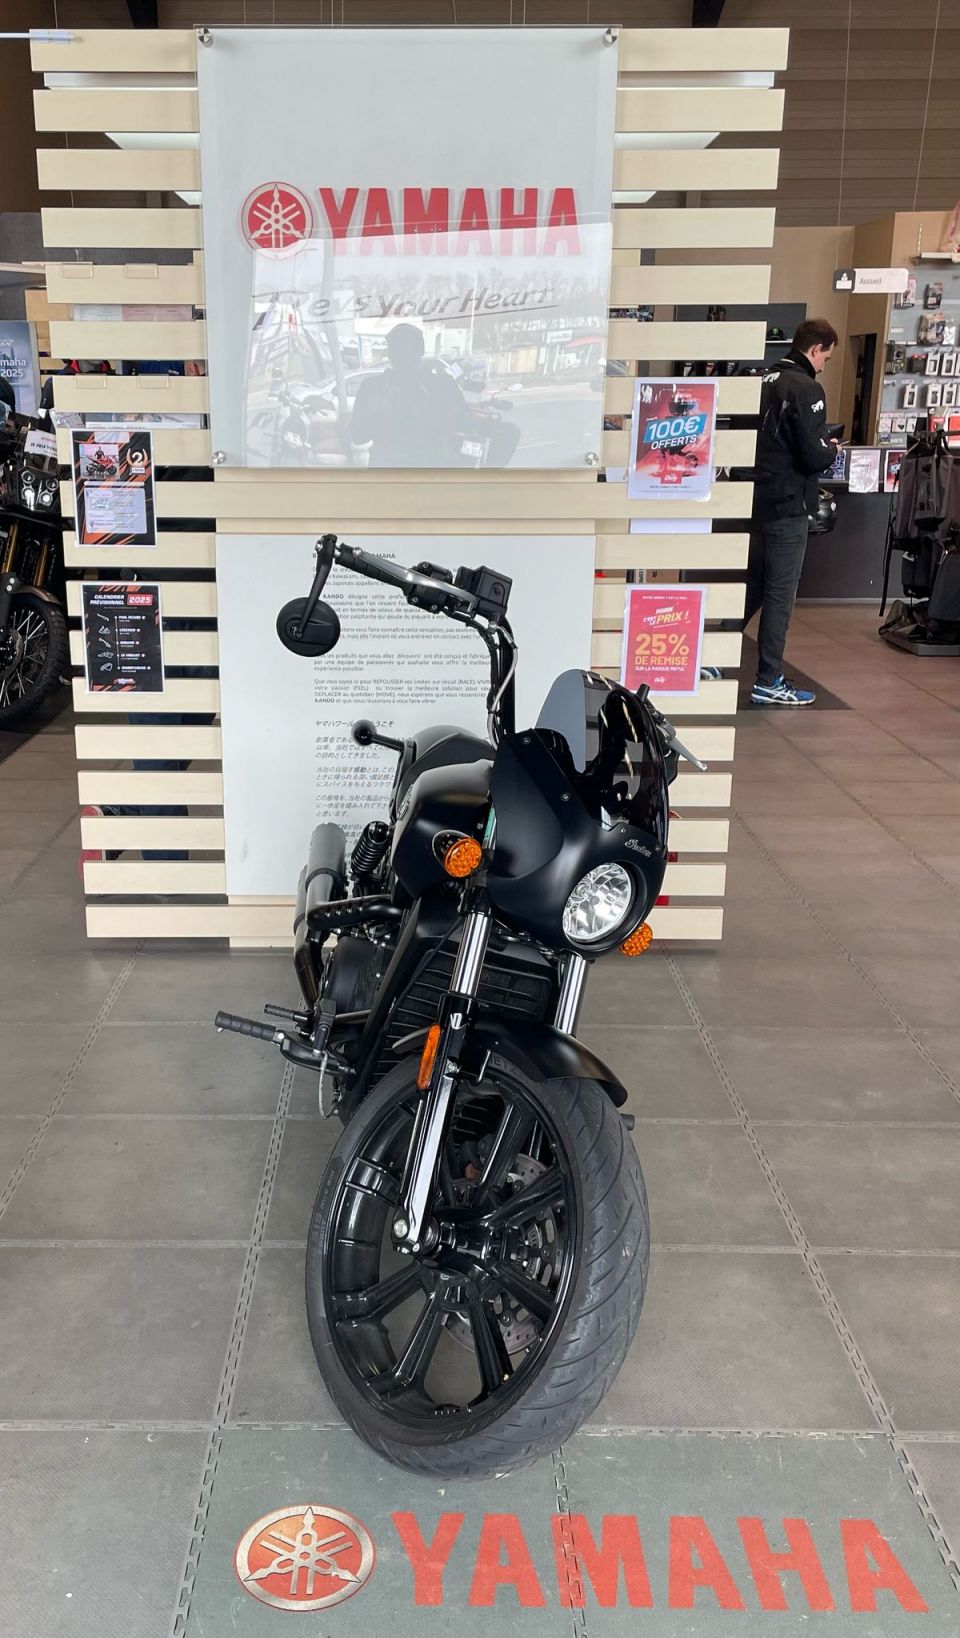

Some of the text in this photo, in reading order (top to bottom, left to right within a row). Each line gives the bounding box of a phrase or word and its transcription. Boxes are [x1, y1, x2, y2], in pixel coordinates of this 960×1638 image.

[319, 187, 582, 257] YAMAHA
[377, 294, 464, 318] Your
[459, 287, 559, 313] Heart
[0, 368, 24, 378] 2025
[649, 416, 701, 440] 100€
[651, 434, 697, 450] OFFERTS
[132, 451, 143, 465] 2
[129, 596, 152, 604] 2025
[657, 612, 682, 624] PRIX
[635, 633, 689, 656] 25%
[635, 656, 688, 666] DE REMISE
[391, 1512, 930, 1615] YAMAHA
